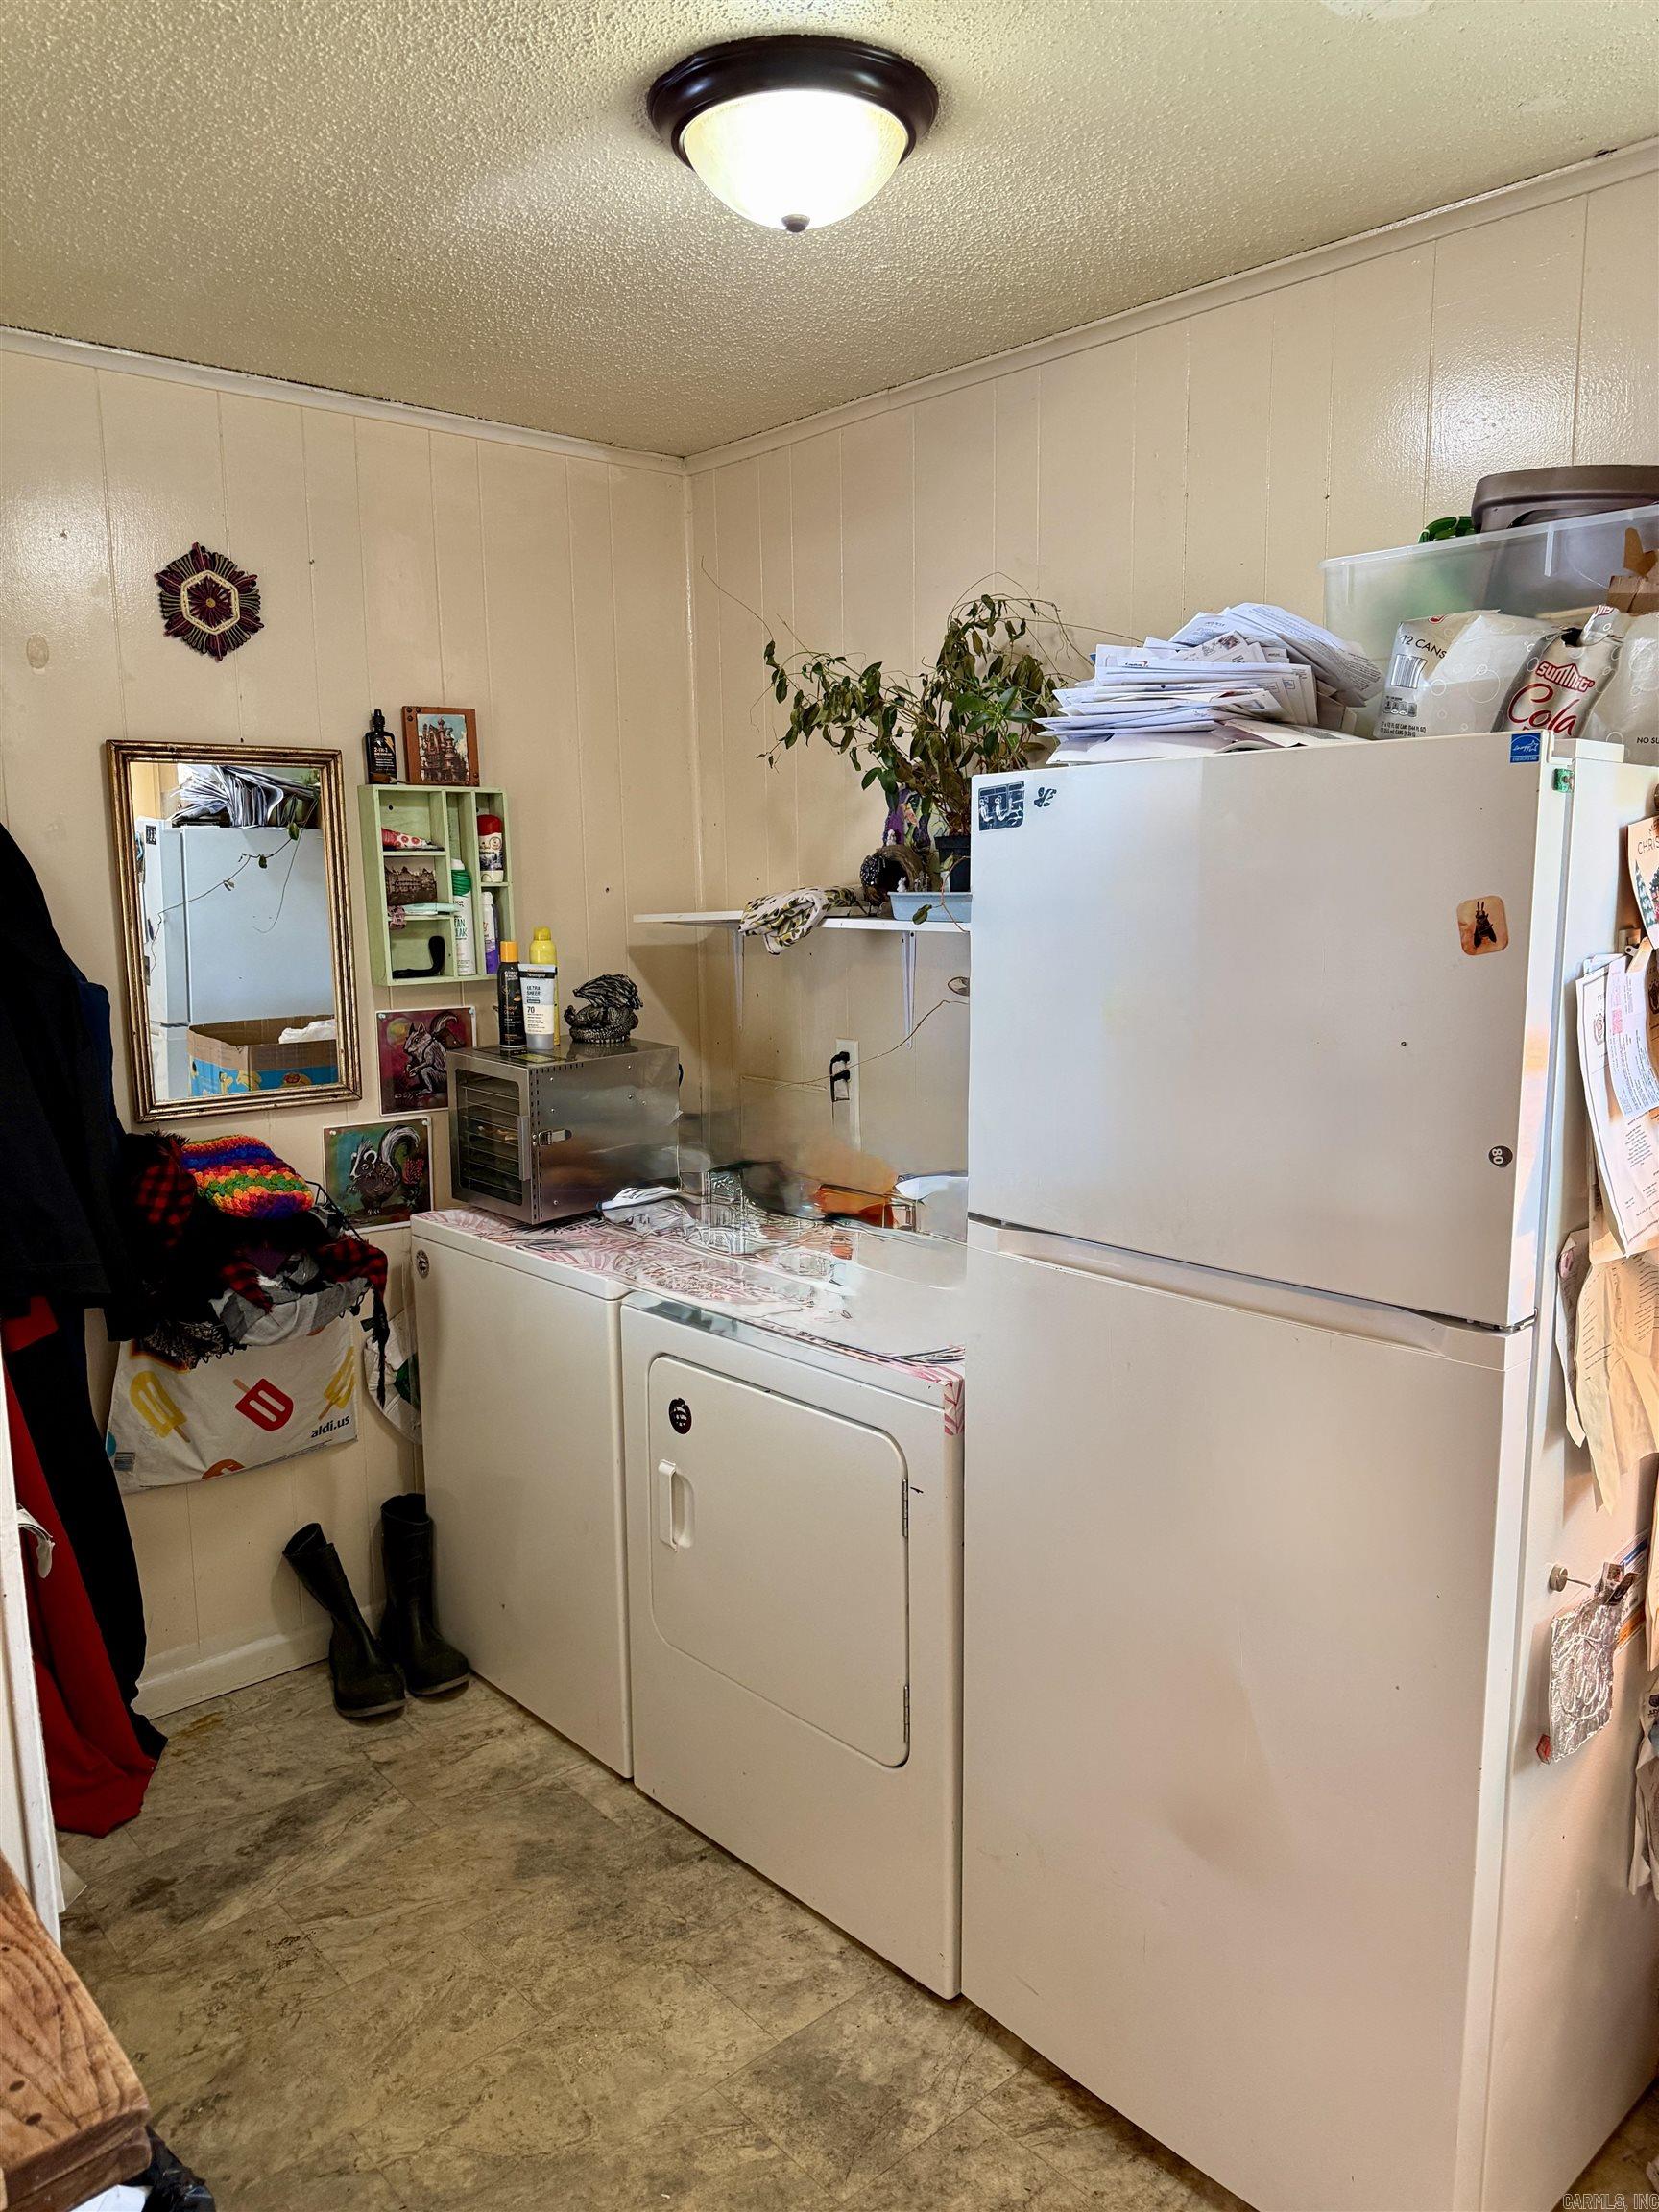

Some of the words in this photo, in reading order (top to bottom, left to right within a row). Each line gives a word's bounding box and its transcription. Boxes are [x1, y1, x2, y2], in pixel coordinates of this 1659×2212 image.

[1401, 635, 1413, 646] 12
[1415, 639, 1447, 660] CANS
[1508, 683, 1580, 736] Cola
[311, 1415, 350, 1438] aldi.us
